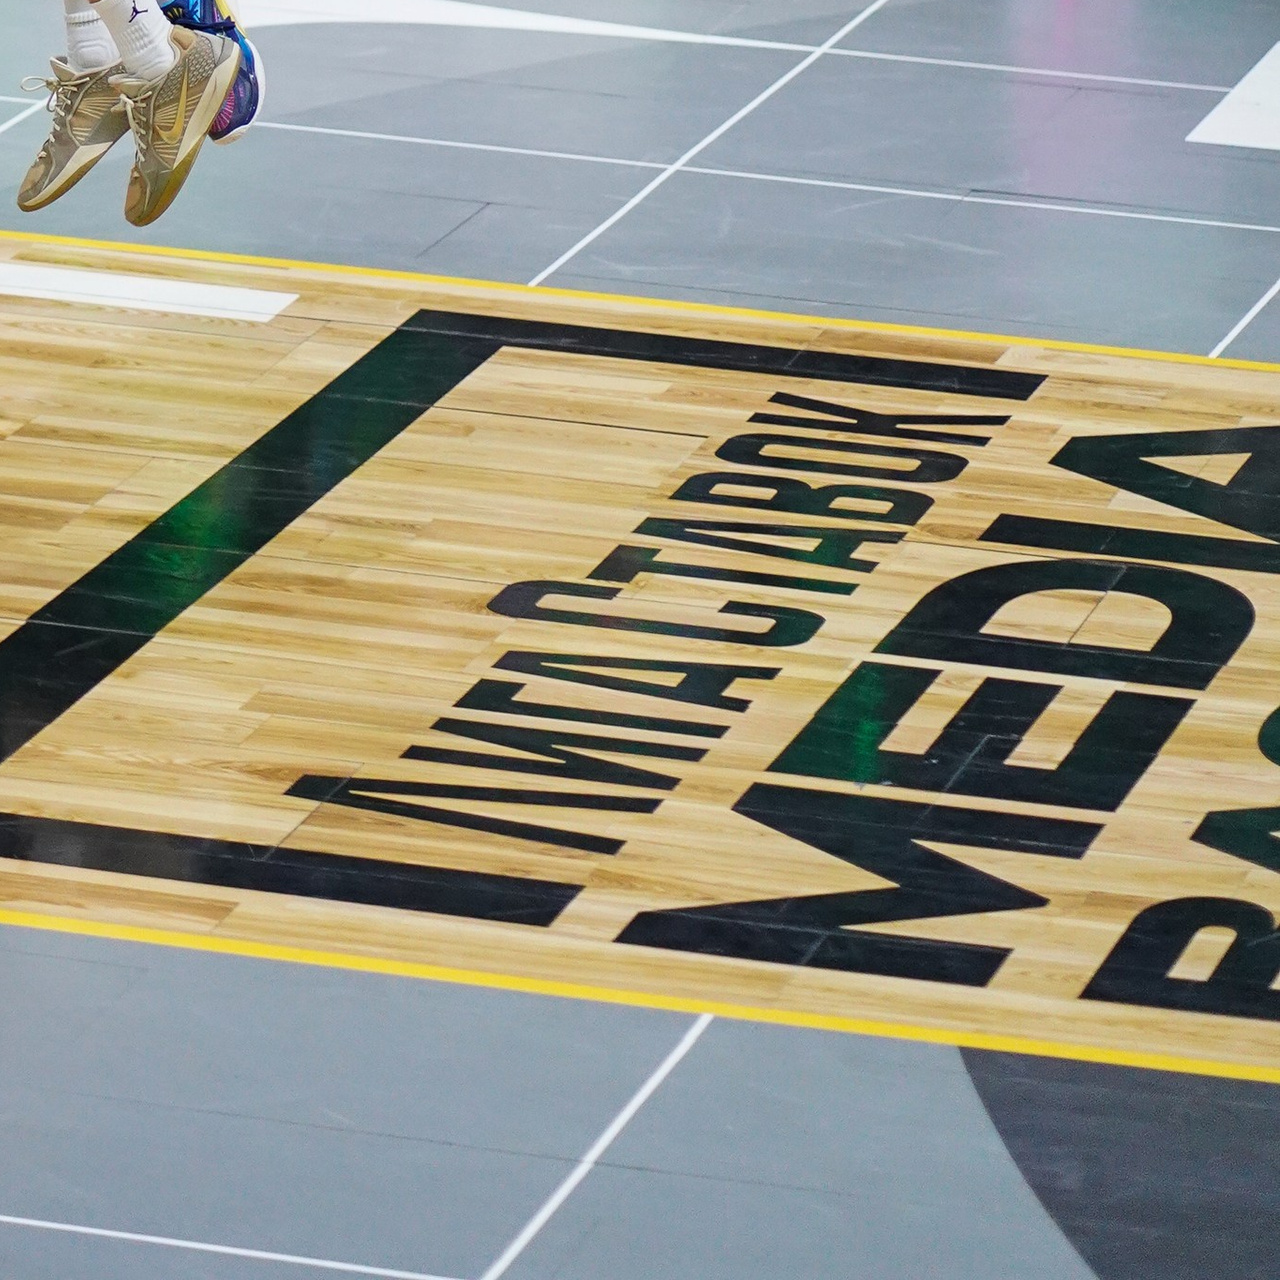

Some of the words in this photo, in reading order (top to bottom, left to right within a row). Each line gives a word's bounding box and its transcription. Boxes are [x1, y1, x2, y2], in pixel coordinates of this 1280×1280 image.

[487, 391, 1013, 647] СТАВОК
[283, 650, 784, 855] ЛИГА
[614, 425, 1280, 987] MEDIA
